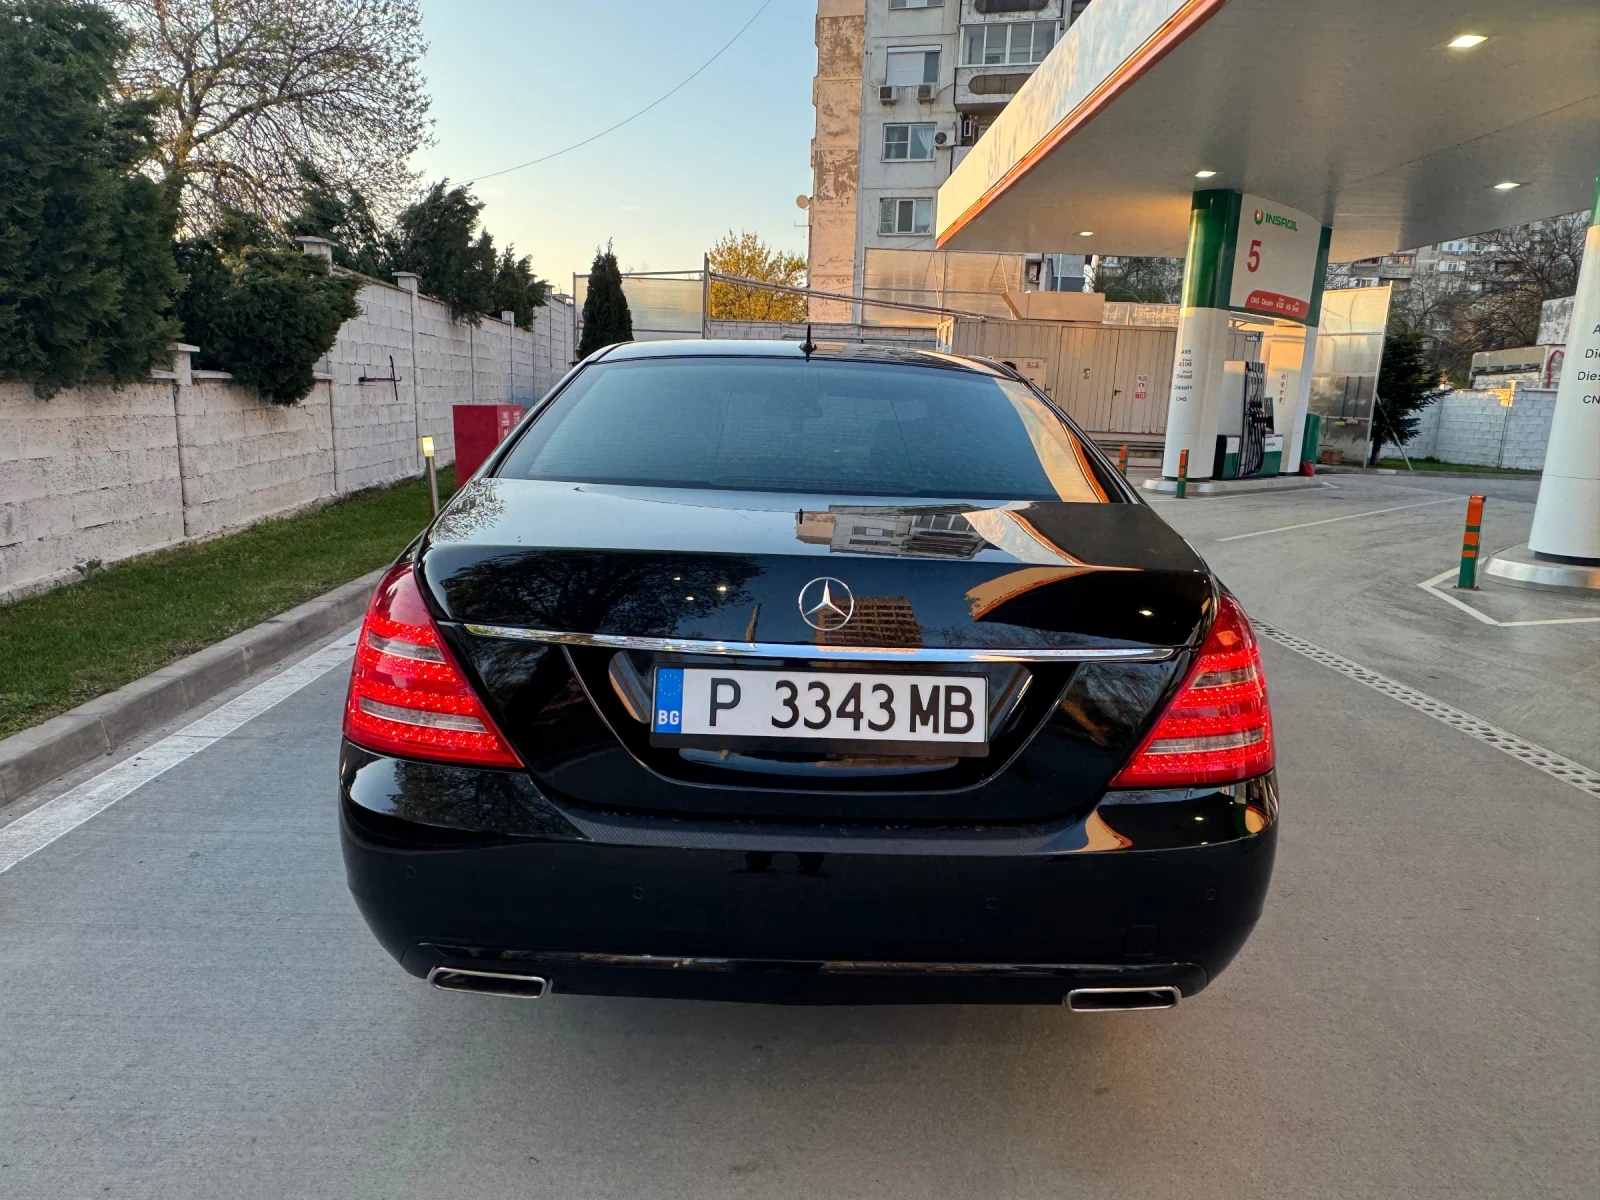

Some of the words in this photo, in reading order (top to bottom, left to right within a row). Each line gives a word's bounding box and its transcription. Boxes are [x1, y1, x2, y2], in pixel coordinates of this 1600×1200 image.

[1247, 239, 1261, 273] 5
[657, 710, 680, 725] BG
[709, 677, 742, 727] P
[771, 679, 896, 732] 3343
[909, 684, 975, 735] MB
